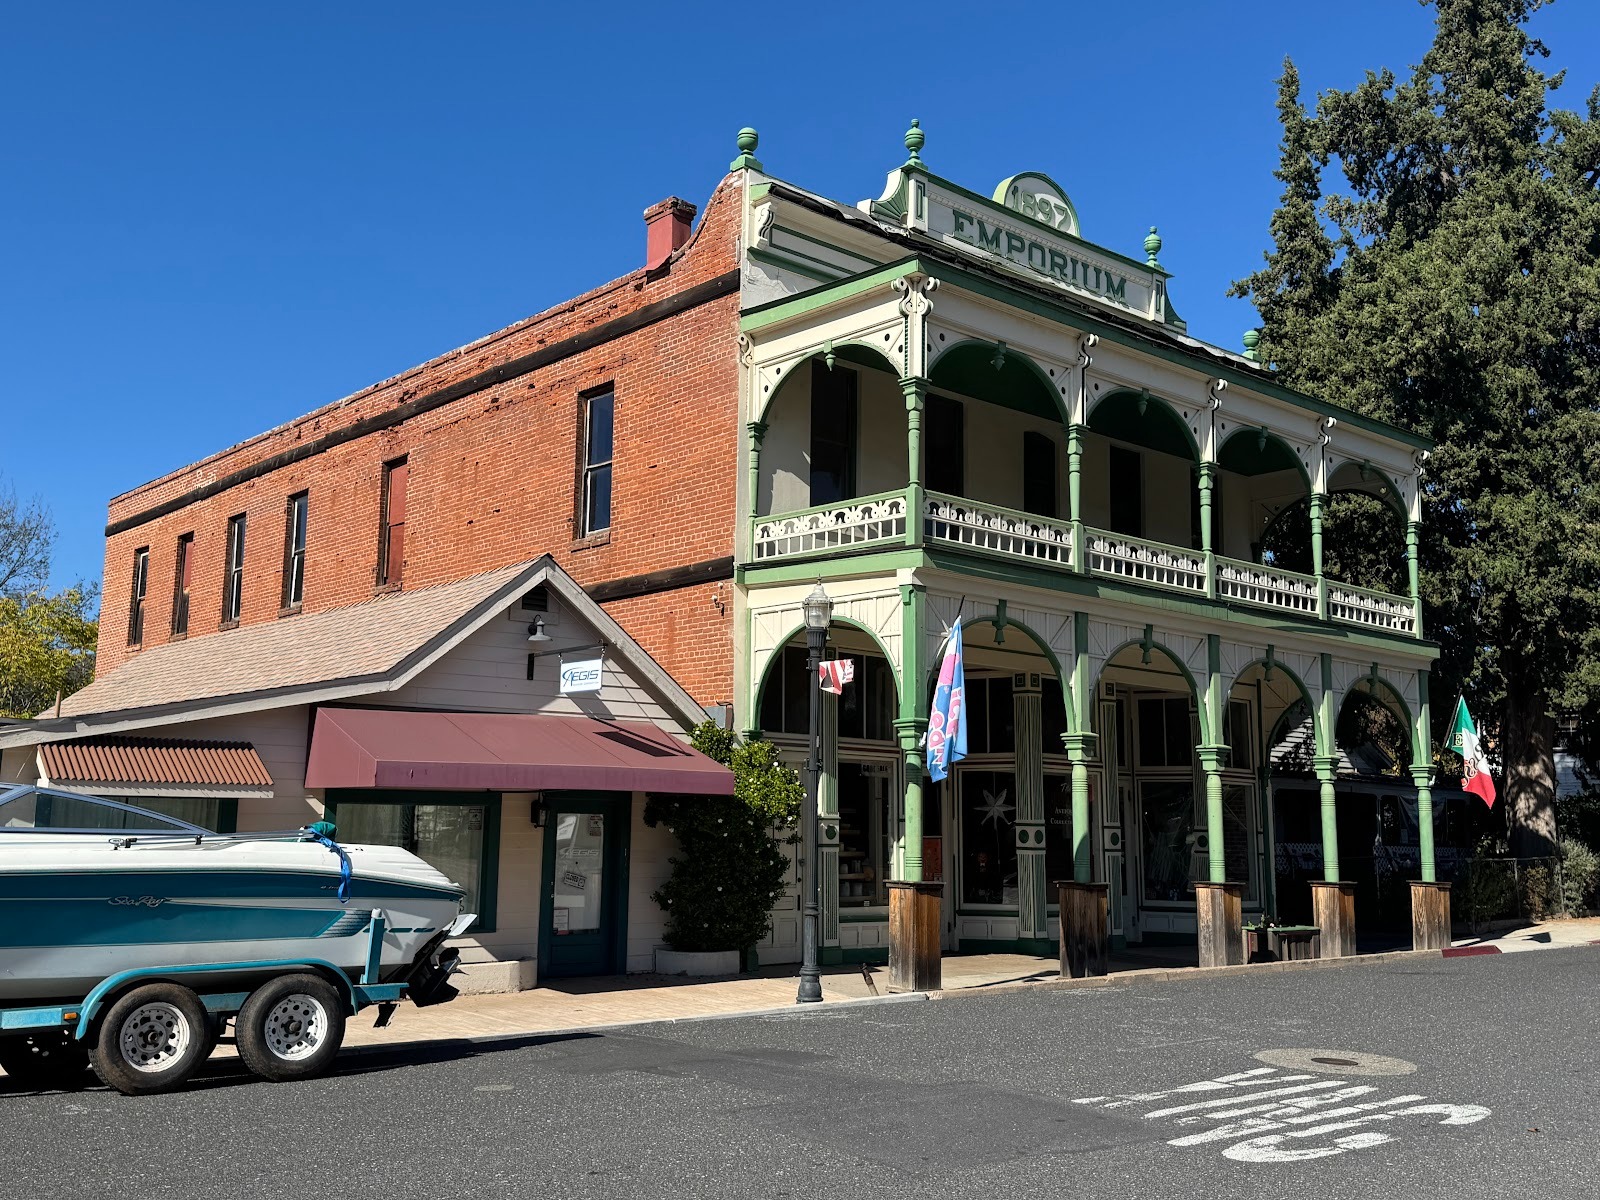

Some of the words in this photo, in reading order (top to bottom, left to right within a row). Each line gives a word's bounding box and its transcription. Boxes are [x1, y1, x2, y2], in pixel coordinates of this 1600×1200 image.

[1011, 185, 1071, 231] 1897
[953, 209, 1129, 305] EMPORIUM
[562, 668, 599, 687] AEGIS
[108, 895, 135, 906] Sea
[135, 895, 165, 908] Ray
[1070, 1067, 1492, 1163] XING
